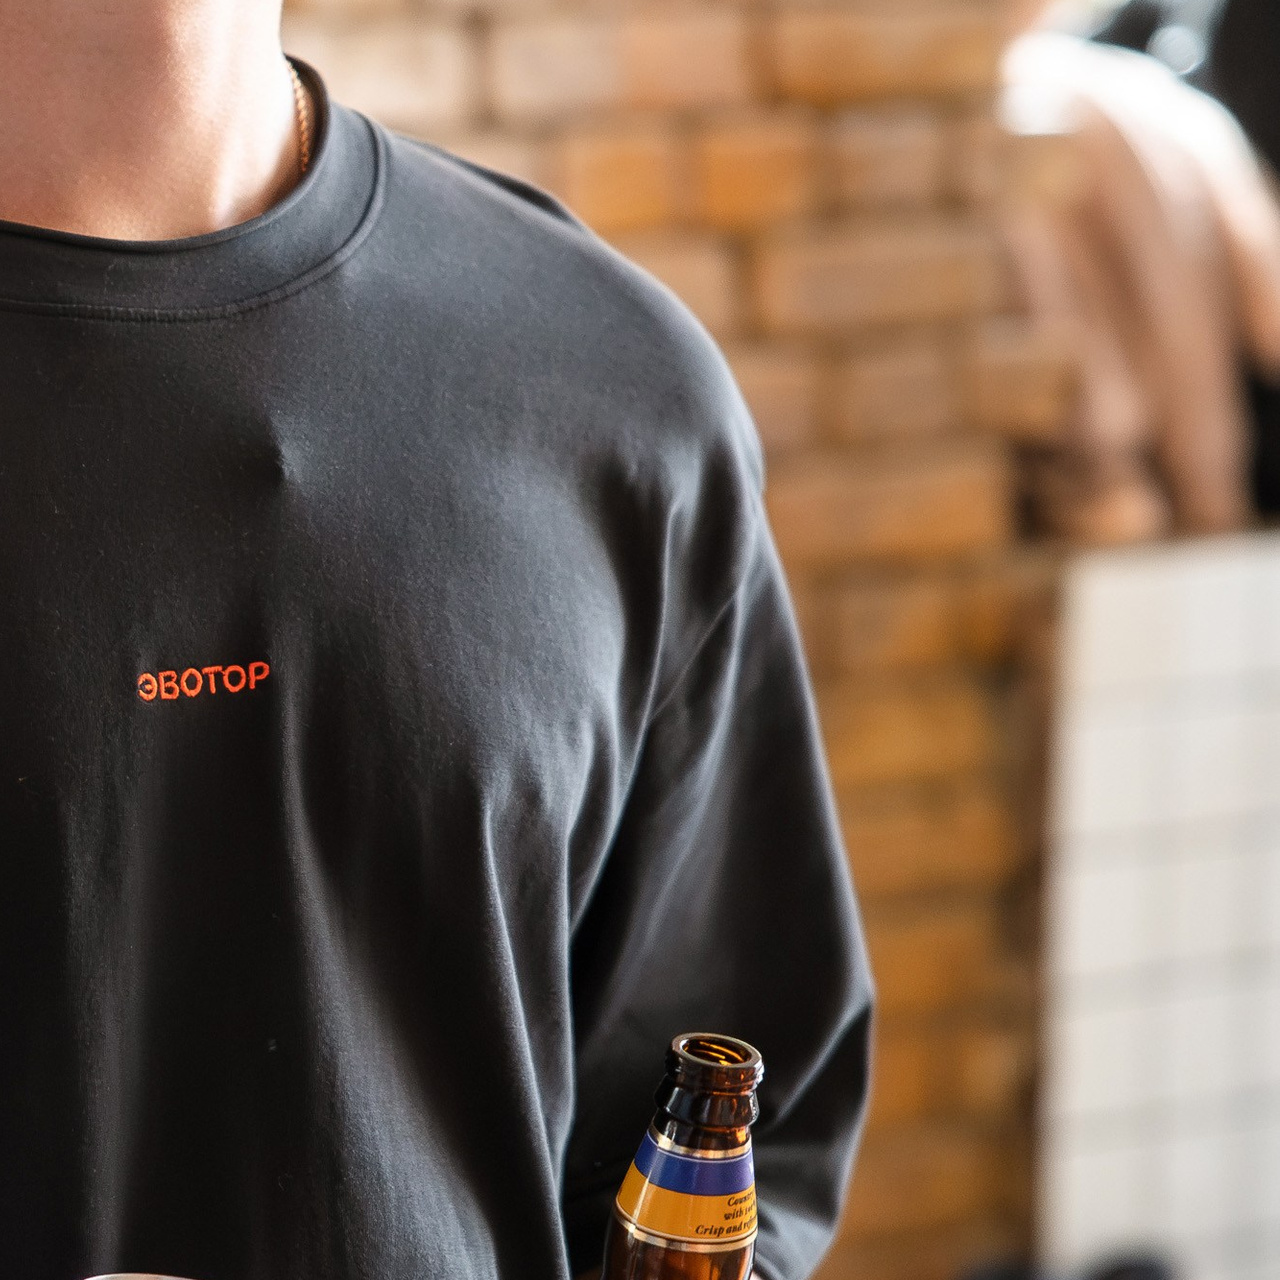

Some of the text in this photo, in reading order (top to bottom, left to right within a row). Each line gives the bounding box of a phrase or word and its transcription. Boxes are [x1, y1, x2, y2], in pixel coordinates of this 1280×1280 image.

[137, 661, 270, 702] ЭВОТОР
[724, 1208, 743, 1221] with
[695, 1224, 725, 1237] Crisp
[726, 1222, 743, 1235] and
